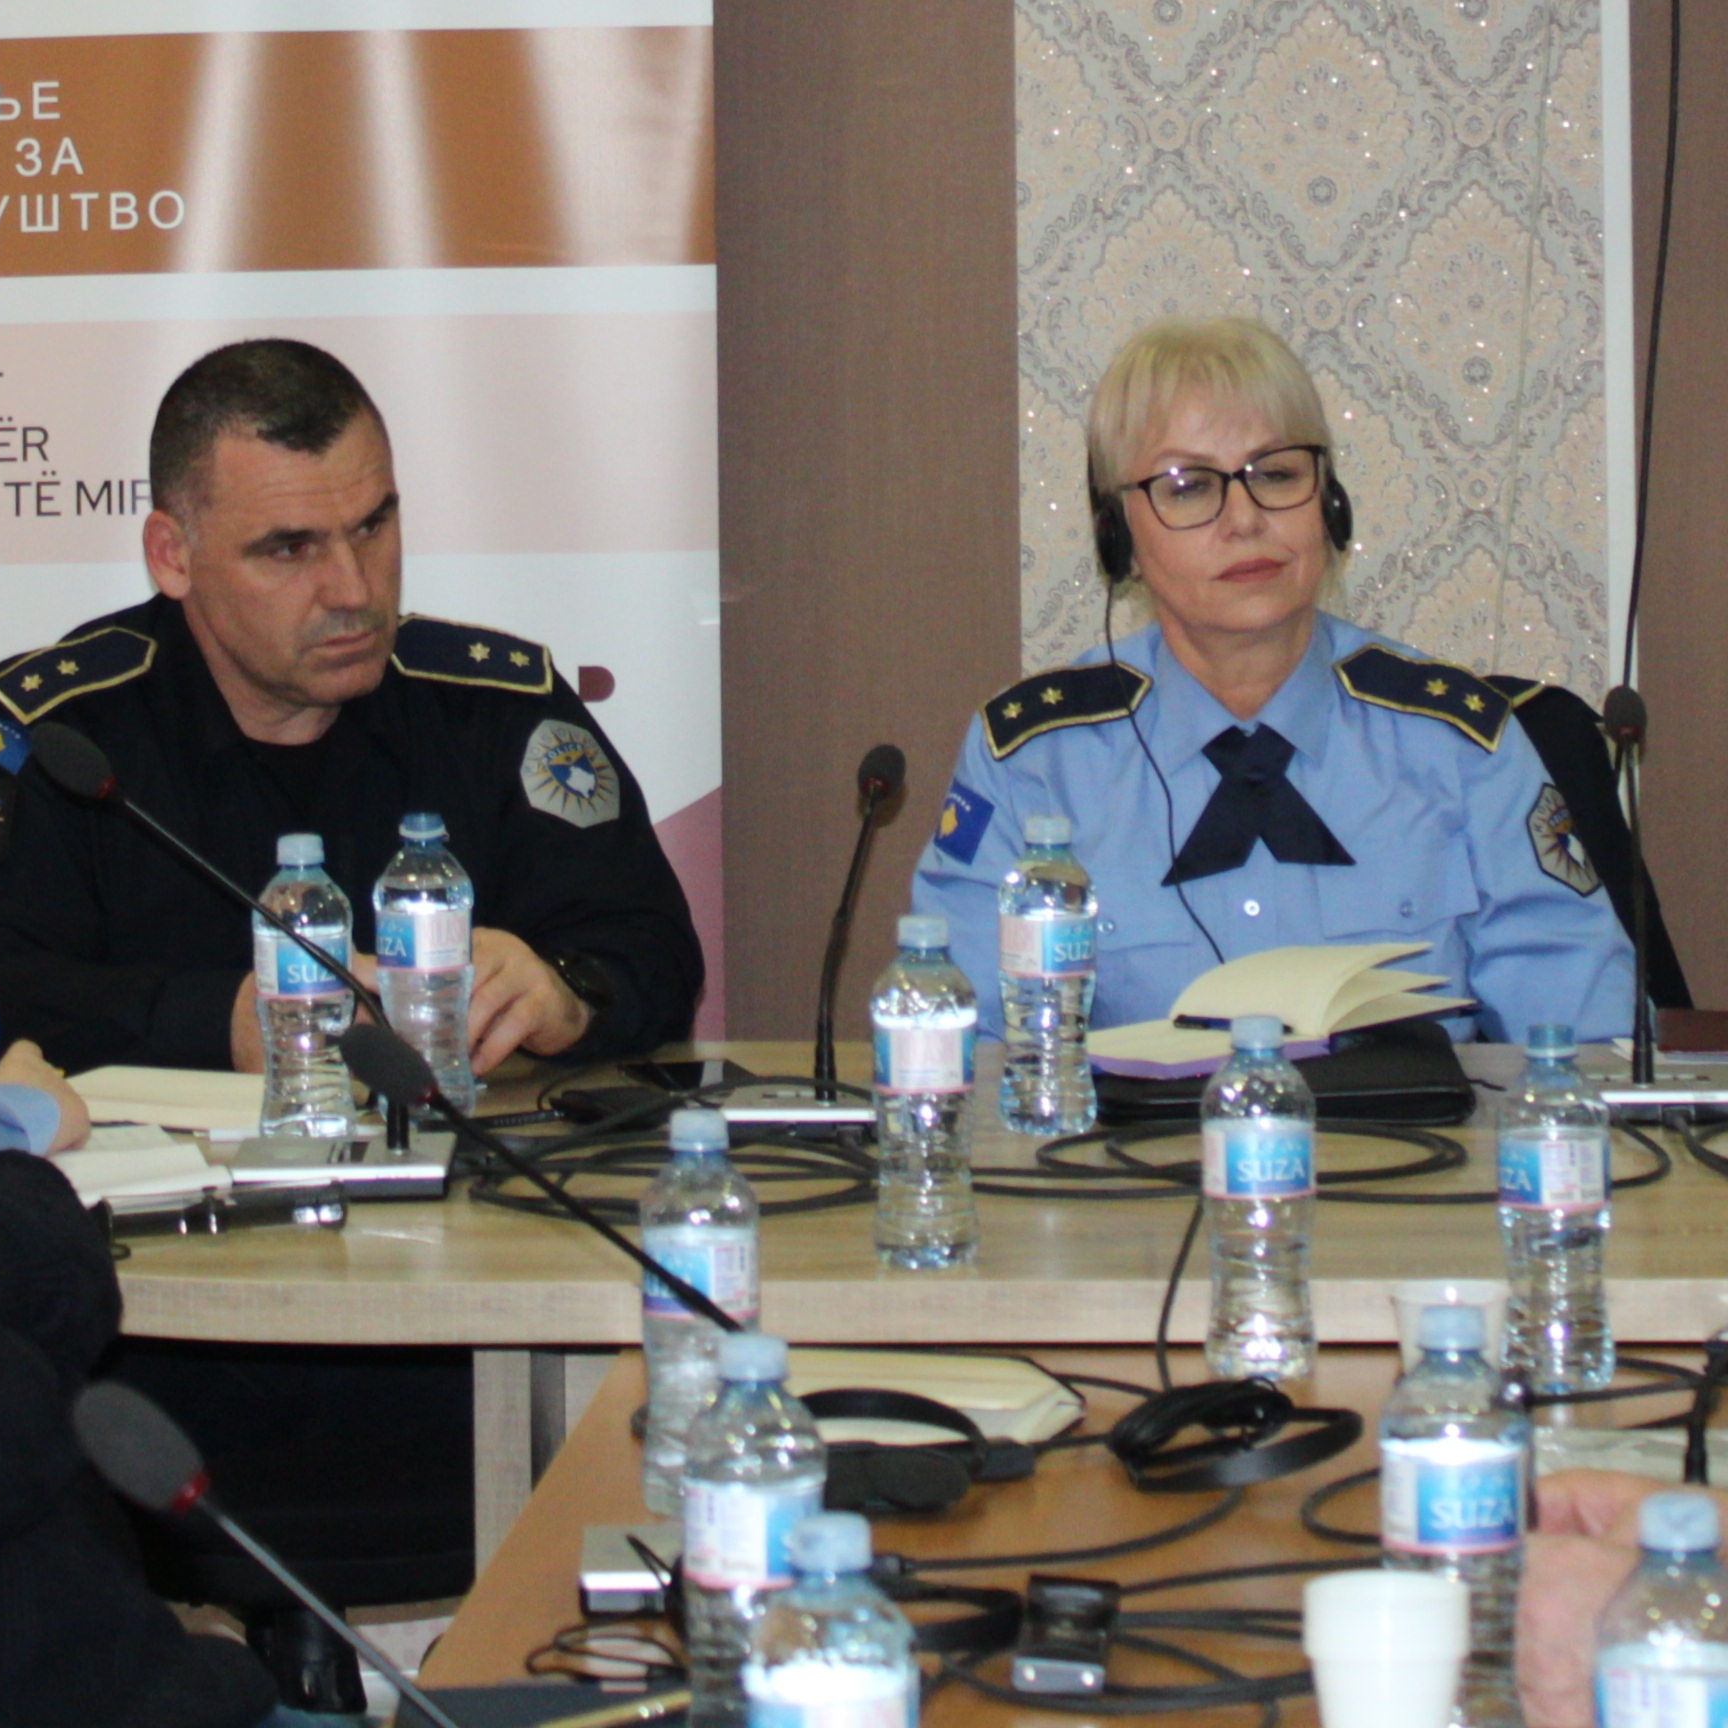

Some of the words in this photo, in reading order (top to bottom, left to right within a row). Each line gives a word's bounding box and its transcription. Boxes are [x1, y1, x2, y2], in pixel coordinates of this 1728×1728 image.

[15, 136, 84, 176] ЗА
[4, 470, 62, 517] TË
[1237, 1158, 1305, 1182] SUZA
